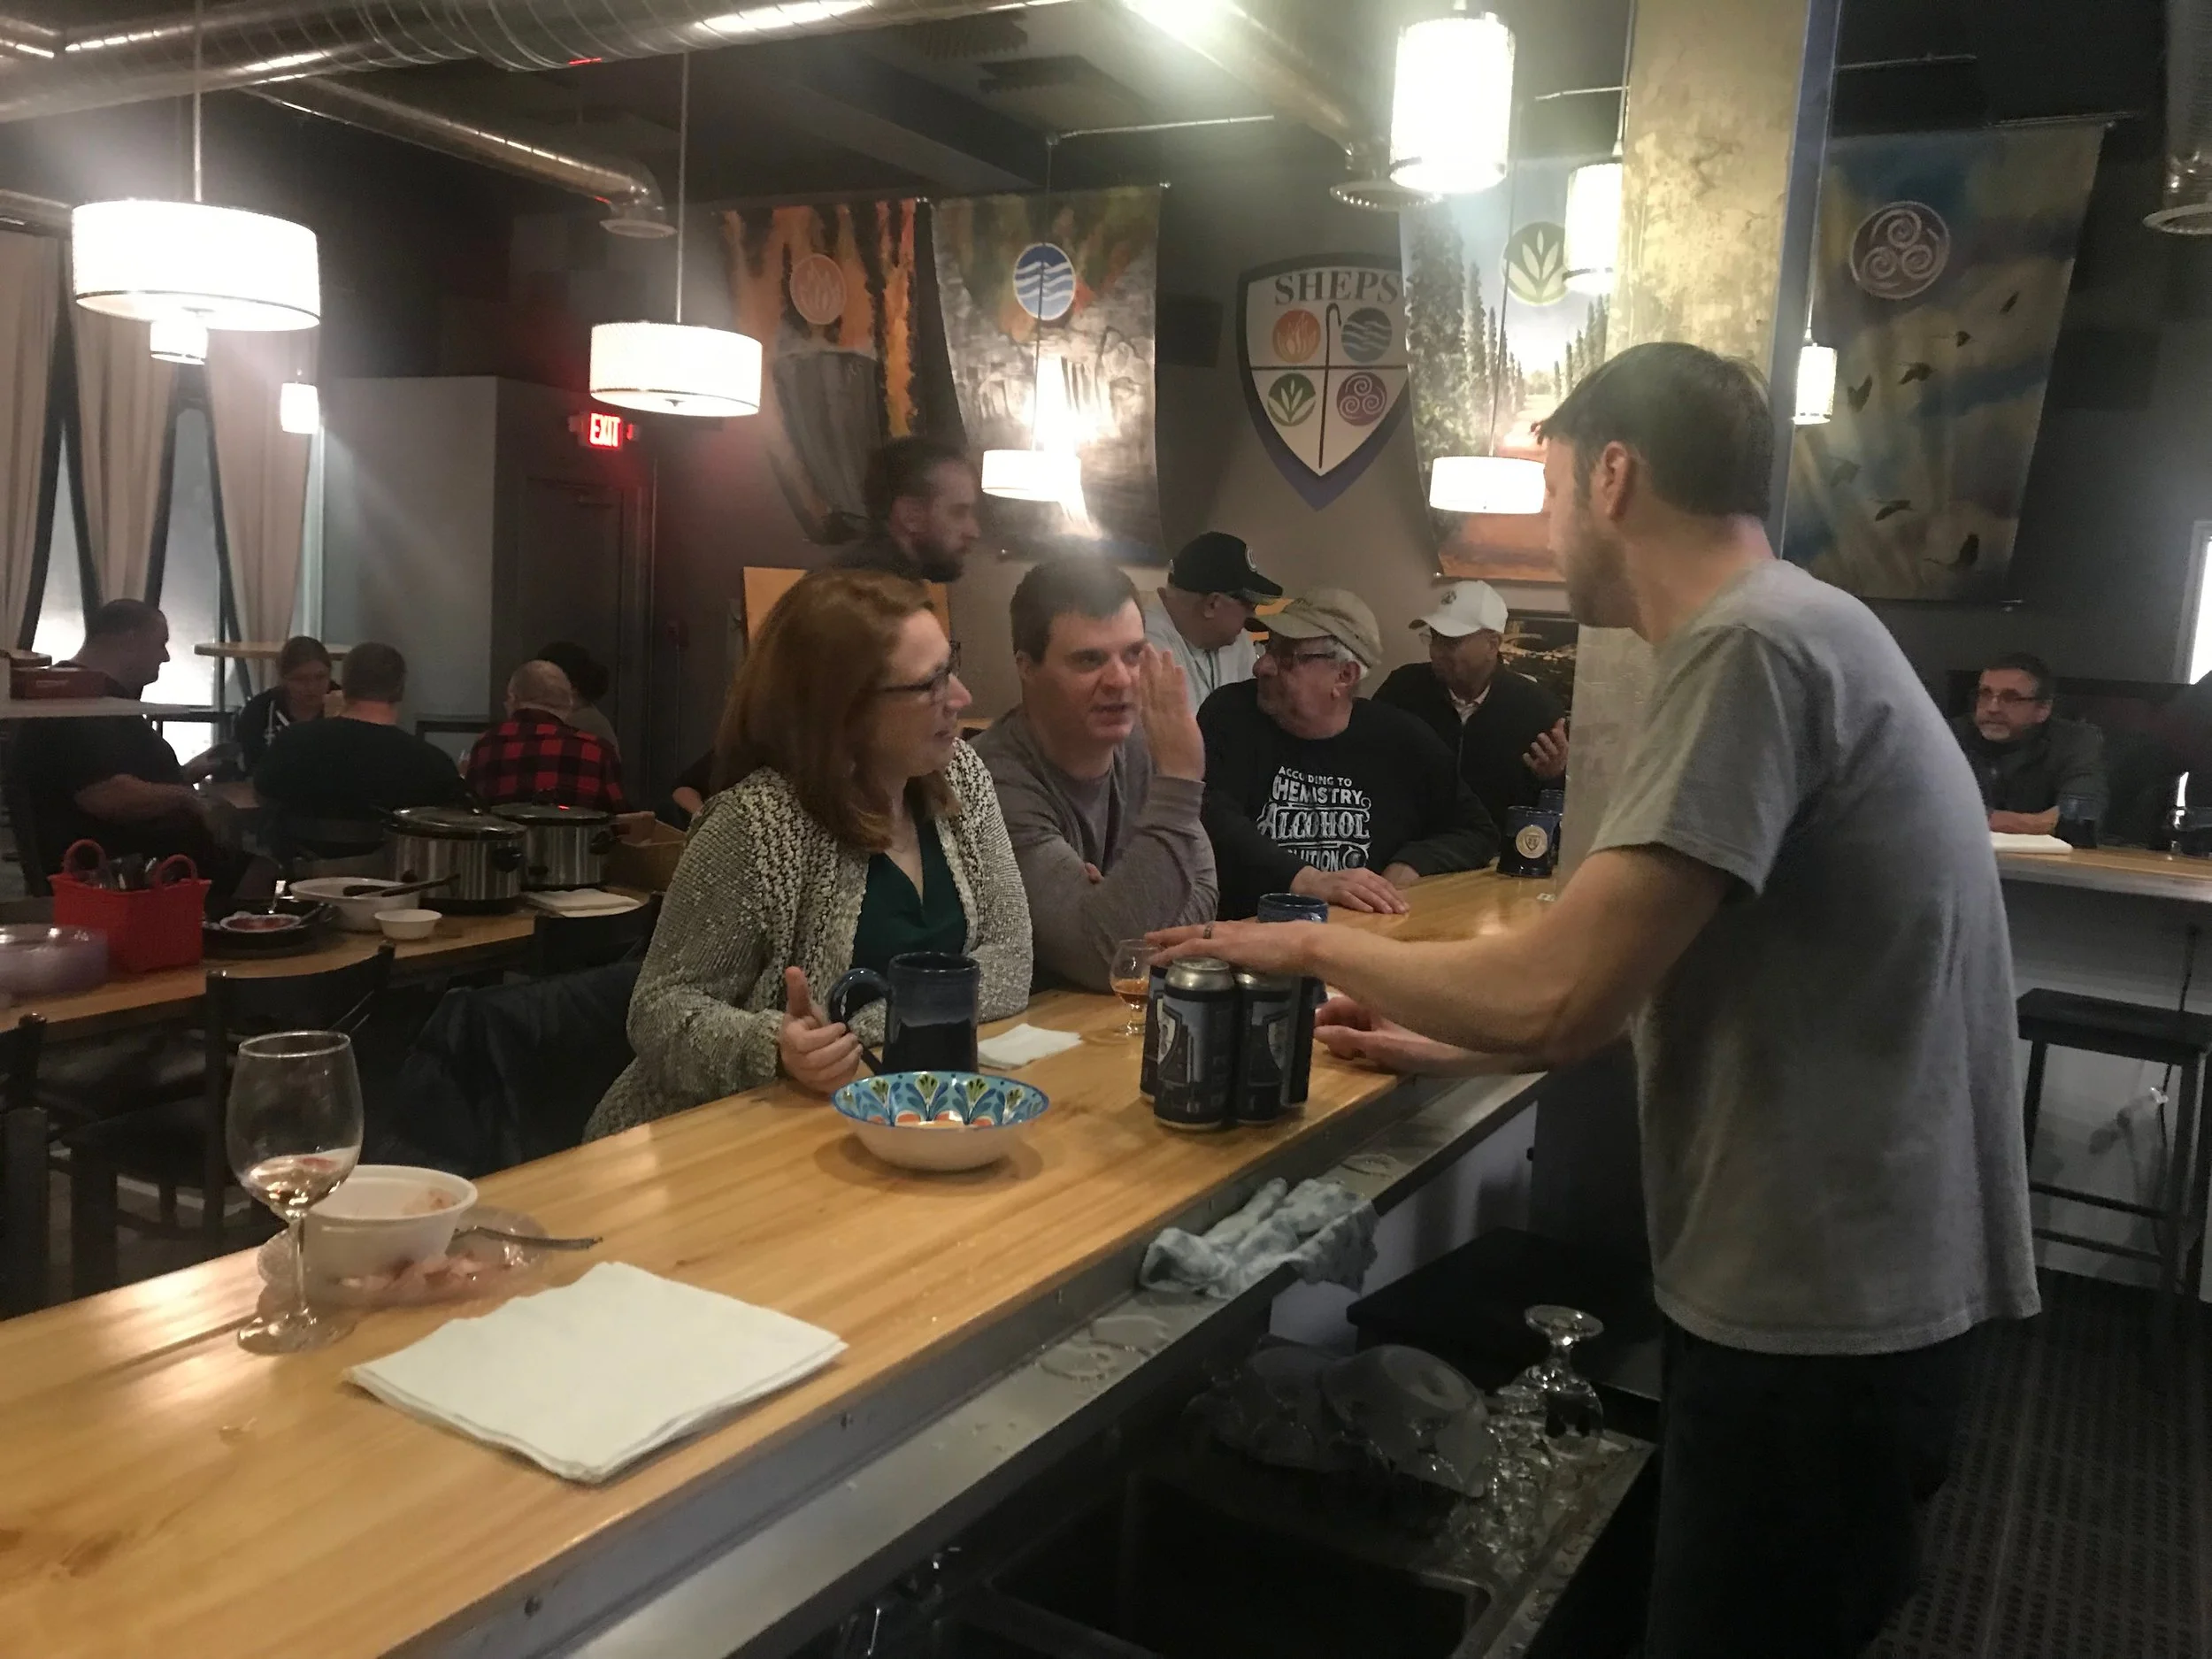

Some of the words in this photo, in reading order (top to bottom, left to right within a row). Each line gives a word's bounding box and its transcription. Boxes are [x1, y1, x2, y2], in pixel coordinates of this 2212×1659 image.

[1275, 270, 1401, 305] SHEPS
[589, 412, 621, 447] EXIT
[1272, 774, 1363, 805] CHEMISTRY
[1337, 777, 1352, 787] TO
[1256, 803, 1371, 840] ALCOHOL
